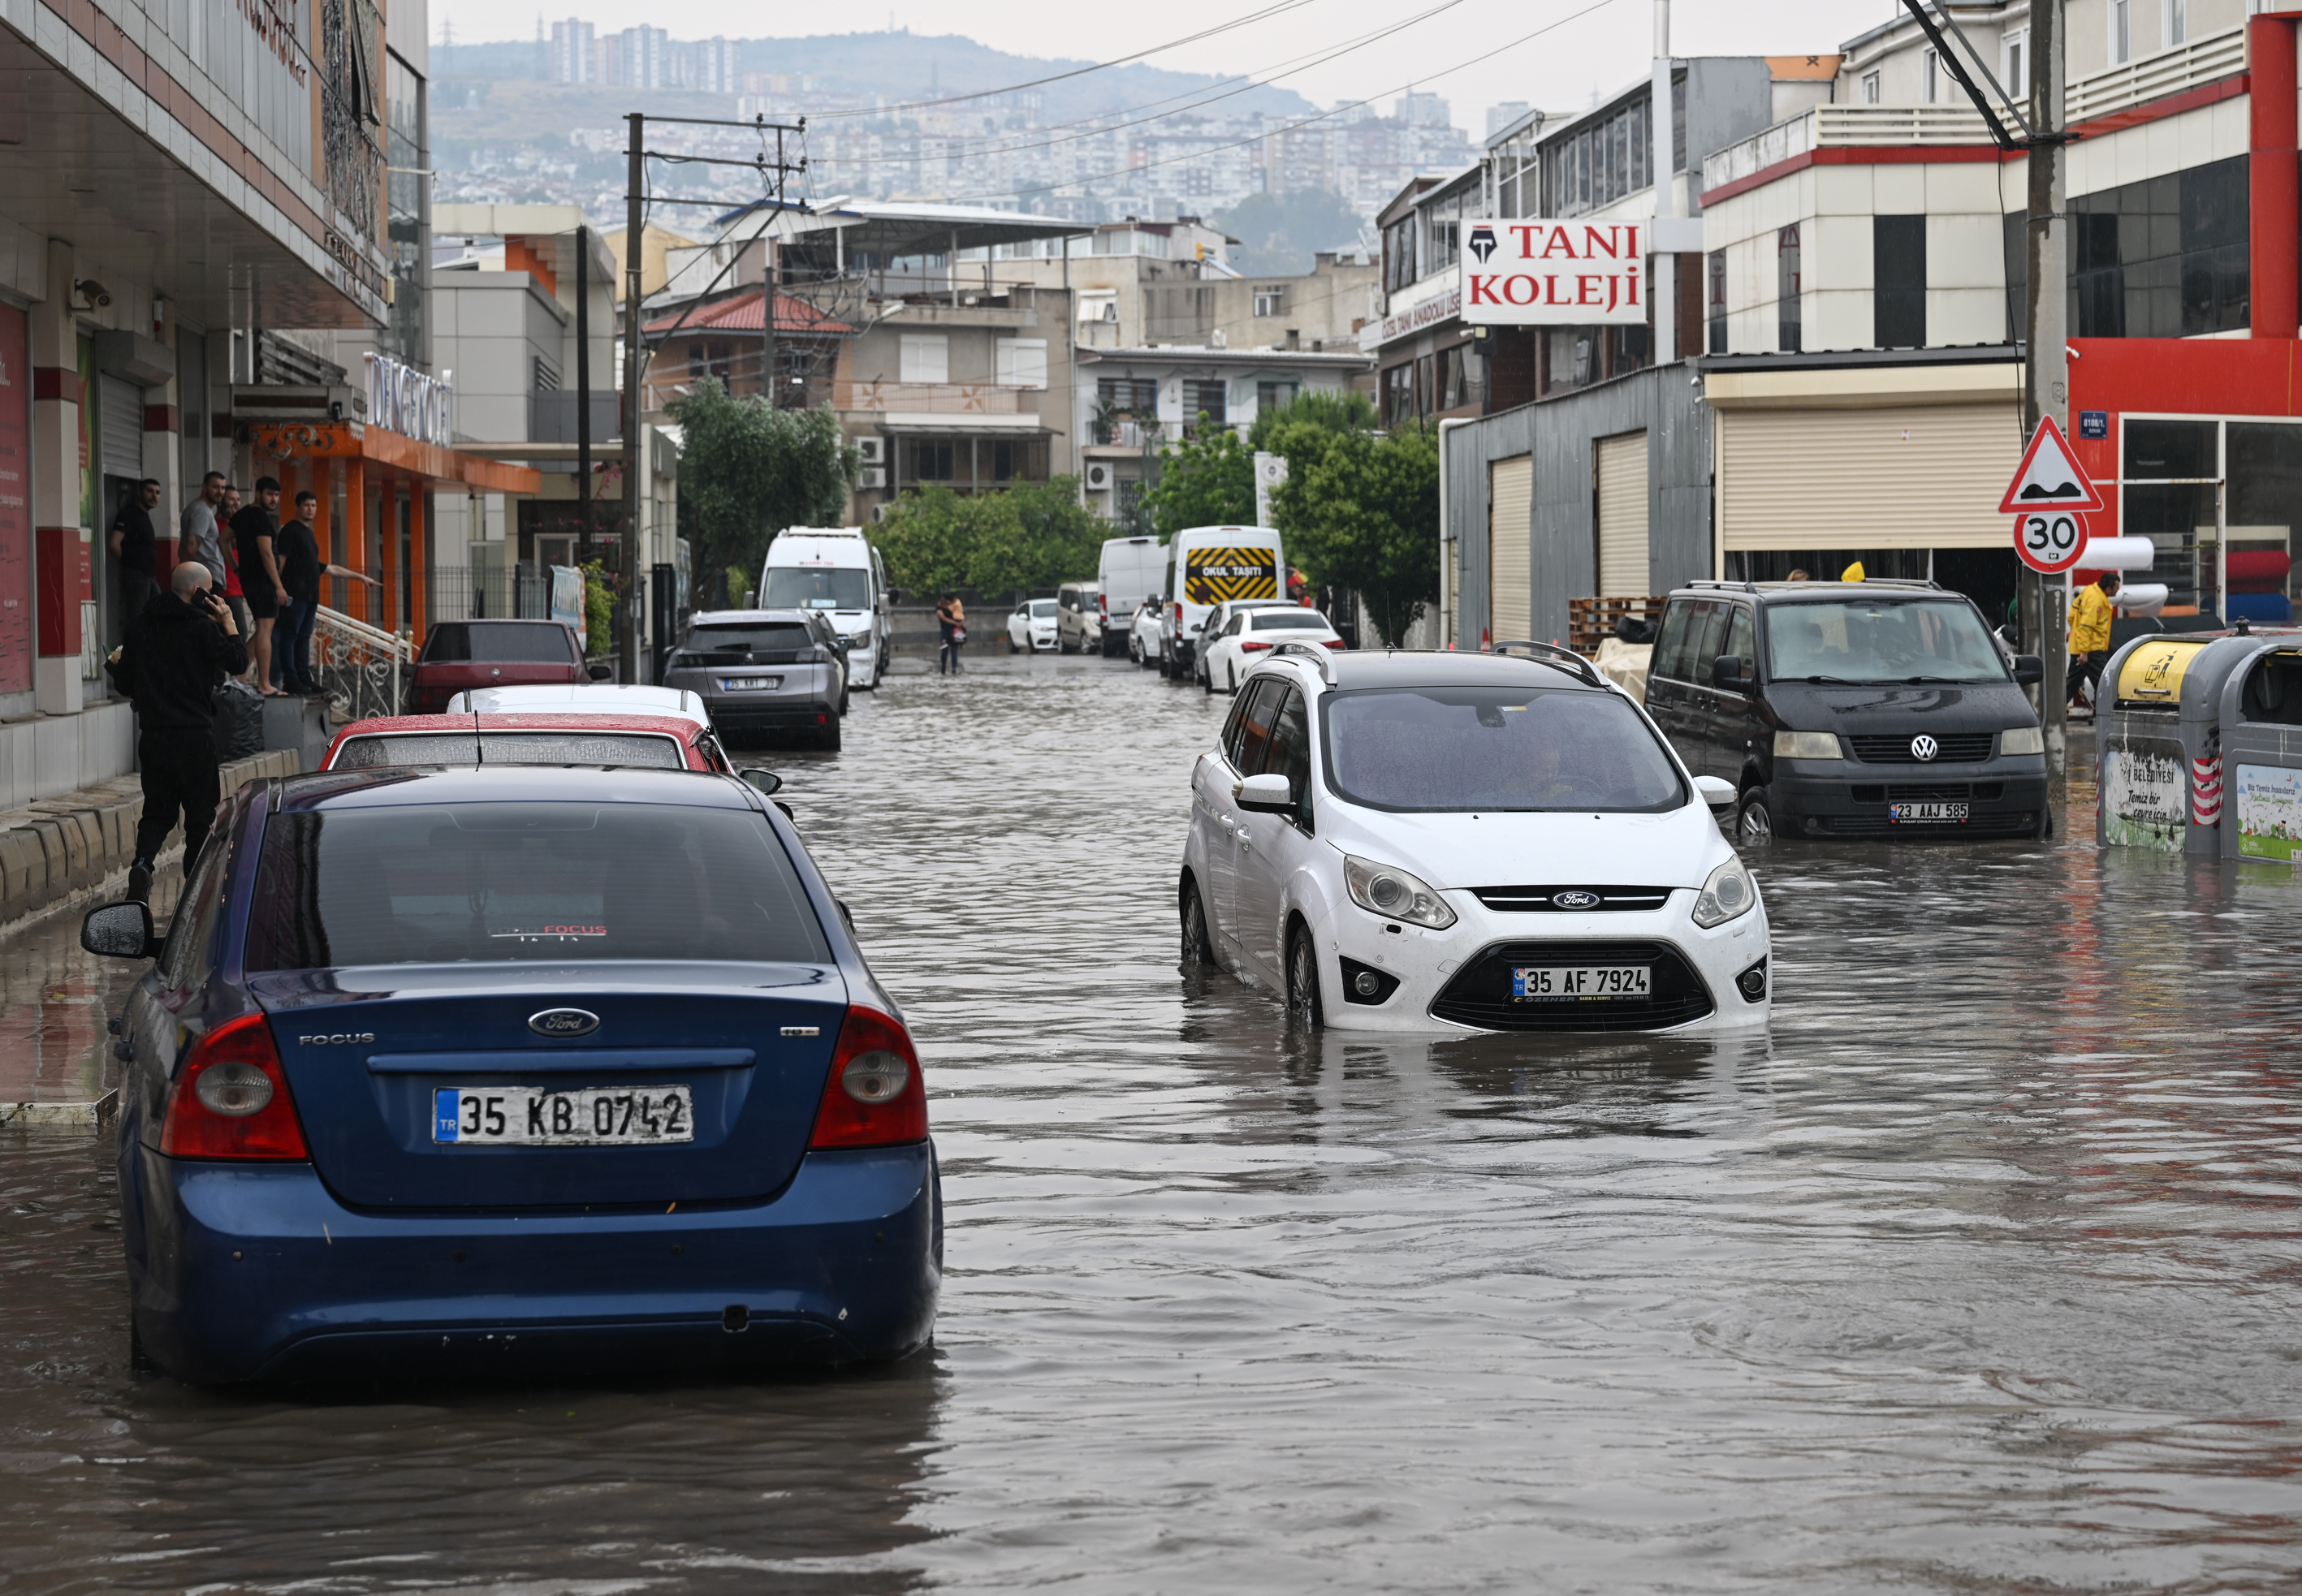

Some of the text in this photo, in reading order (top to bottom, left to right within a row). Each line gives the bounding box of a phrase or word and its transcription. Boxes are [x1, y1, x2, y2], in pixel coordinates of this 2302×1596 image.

[1509, 226, 1640, 259] TANI
[1468, 266, 1639, 313] KOLEJİ
[1382, 318, 1397, 340] ÖZEL
[1397, 312, 1412, 334] TANI
[1413, 299, 1445, 327] ANADOLU
[2027, 517, 2075, 550] 30
[1202, 566, 1262, 578] OKUL TAŞITI
[730, 679, 740, 688] 35
[745, 679, 758, 688] KRT
[2256, 784, 2270, 792] Temiz
[2128, 790, 2161, 805] Temiz bir
[1898, 804, 1912, 817] 23
[1920, 804, 1941, 817] AAJ
[1946, 804, 1967, 817] 585
[2133, 809, 2153, 821] çevre
[1564, 893, 1589, 904] Ford
[544, 925, 607, 934] FOCUS
[1527, 971, 1552, 994] 35
[1563, 970, 1588, 993] AF
[1596, 969, 1648, 993] 7924
[545, 1013, 582, 1030] Ford
[299, 1033, 375, 1046] FOCUS
[439, 1093, 689, 1136] TR 35 KB 0742
